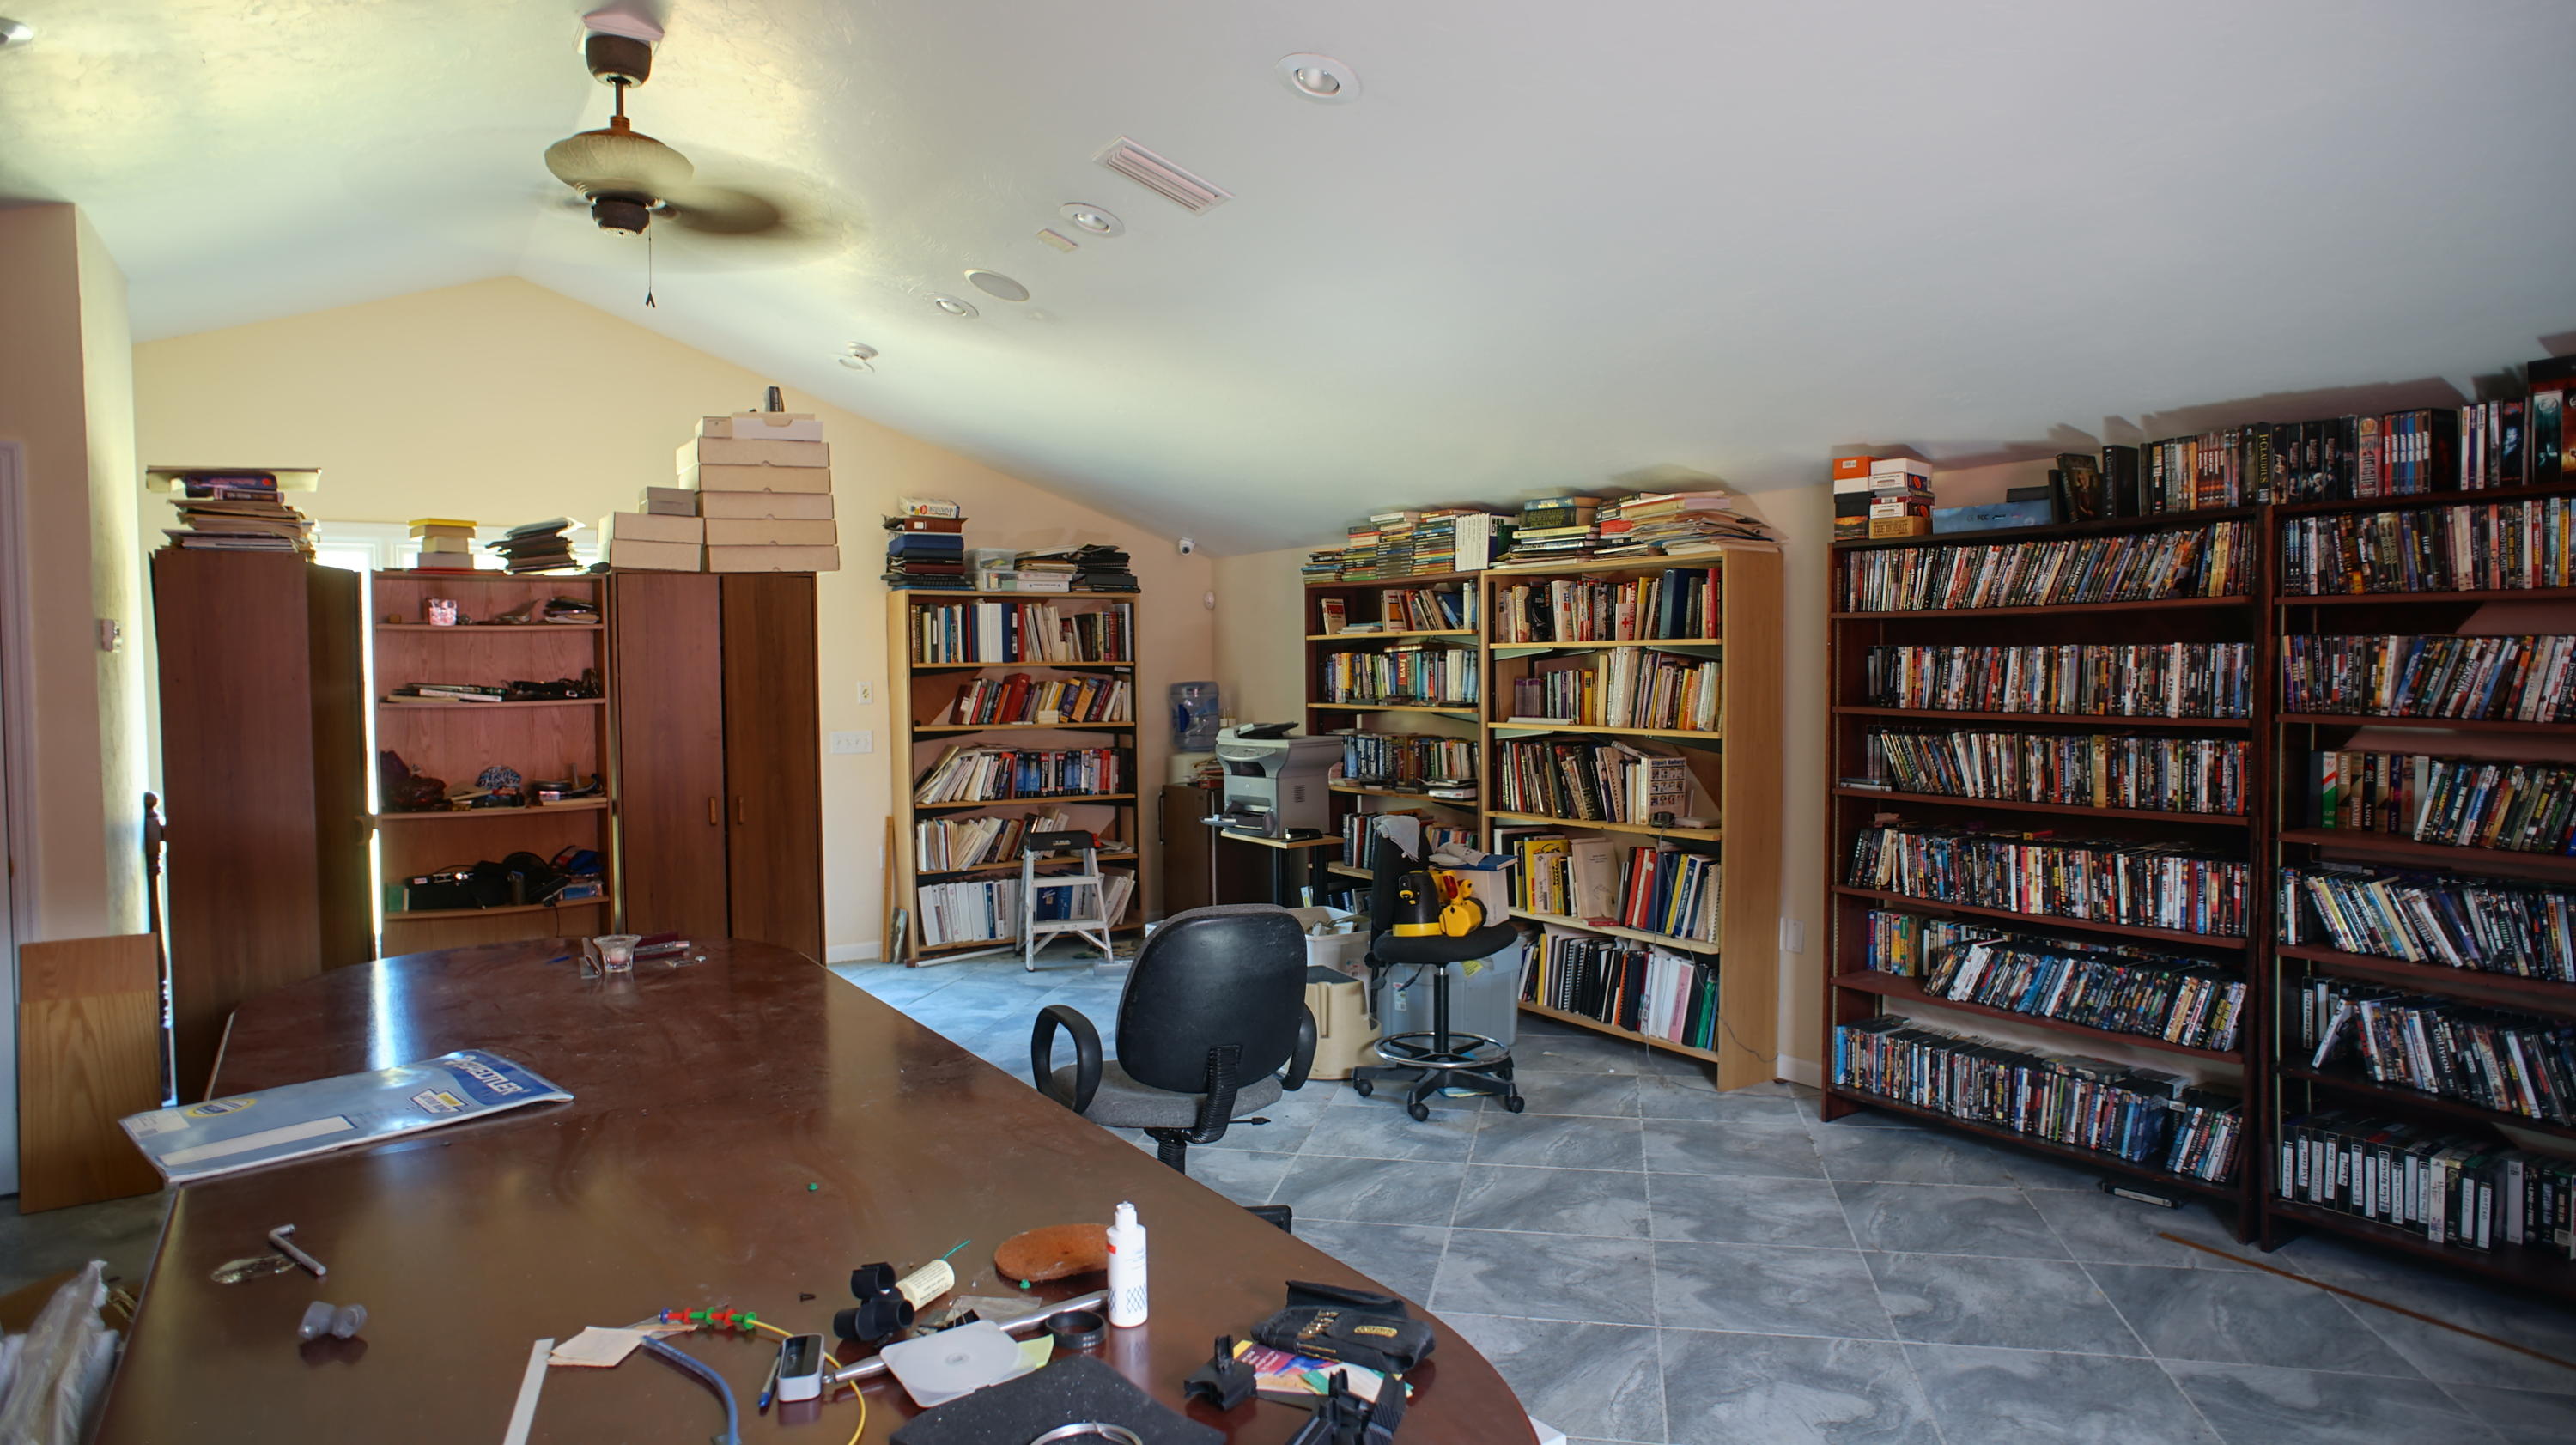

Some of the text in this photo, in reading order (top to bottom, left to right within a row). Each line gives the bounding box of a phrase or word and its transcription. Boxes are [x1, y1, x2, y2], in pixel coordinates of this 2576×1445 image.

[2340, 756, 2349, 785] maxell
[2378, 757, 2387, 787] maxell
[2433, 1029, 2451, 1073] OBLIVION
